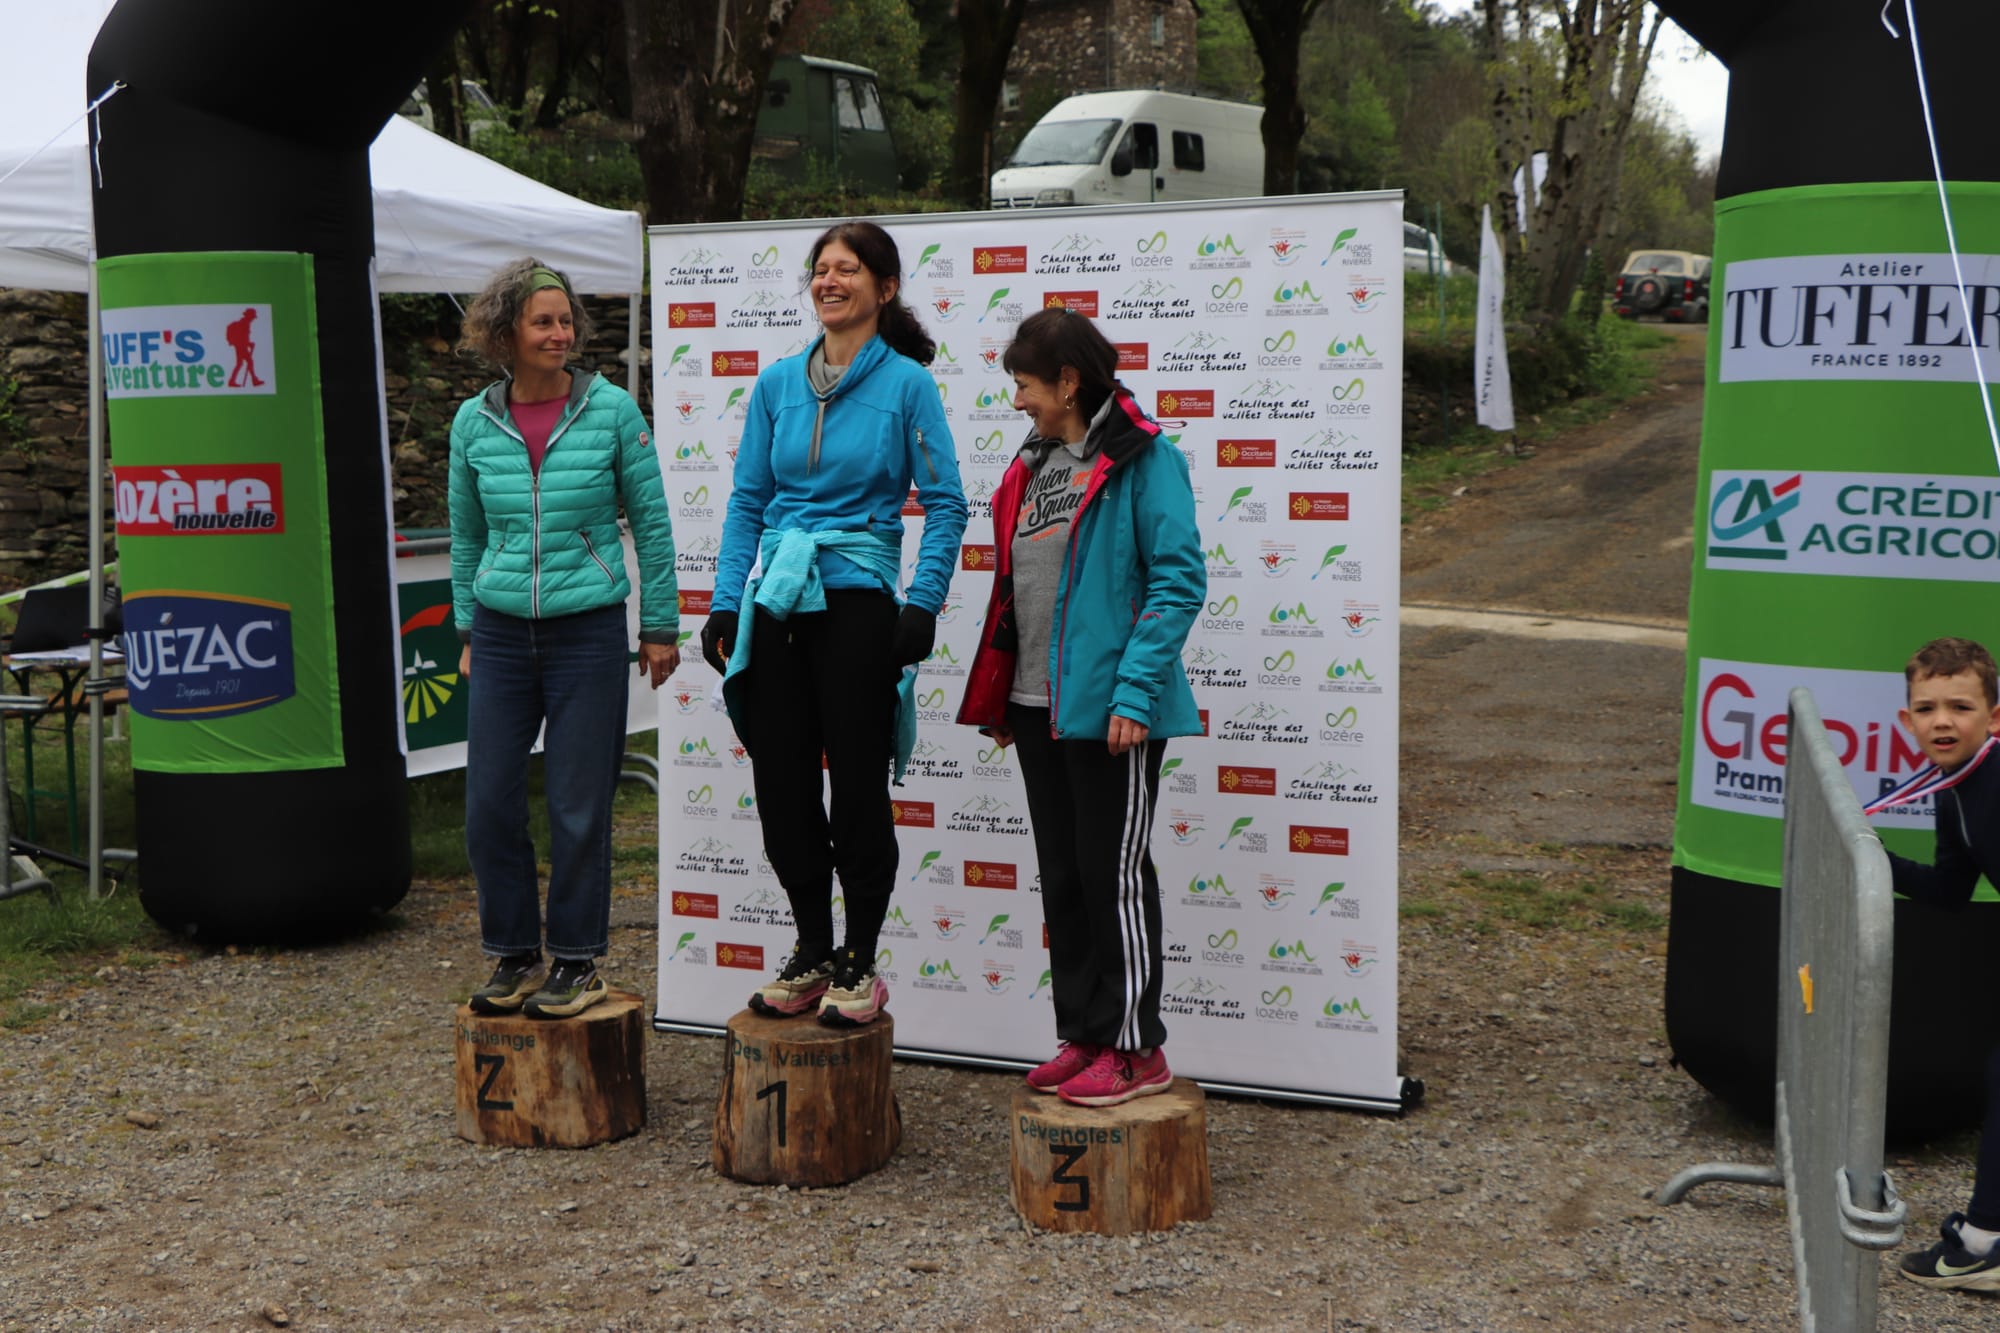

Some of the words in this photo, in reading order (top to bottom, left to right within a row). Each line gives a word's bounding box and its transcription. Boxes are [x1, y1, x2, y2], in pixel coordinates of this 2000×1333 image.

[1840, 262, 1925, 277] Atelier
[1811, 354, 1889, 368] FRANCE
[1898, 354, 1942, 368] 1892
[1836, 482, 2000, 520] CRÉDI
[173, 509, 276, 531] nouvelle
[1799, 523, 2000, 560] AGRICO
[756, 1080, 788, 1148] 1
[1048, 1143, 1090, 1212] 3
